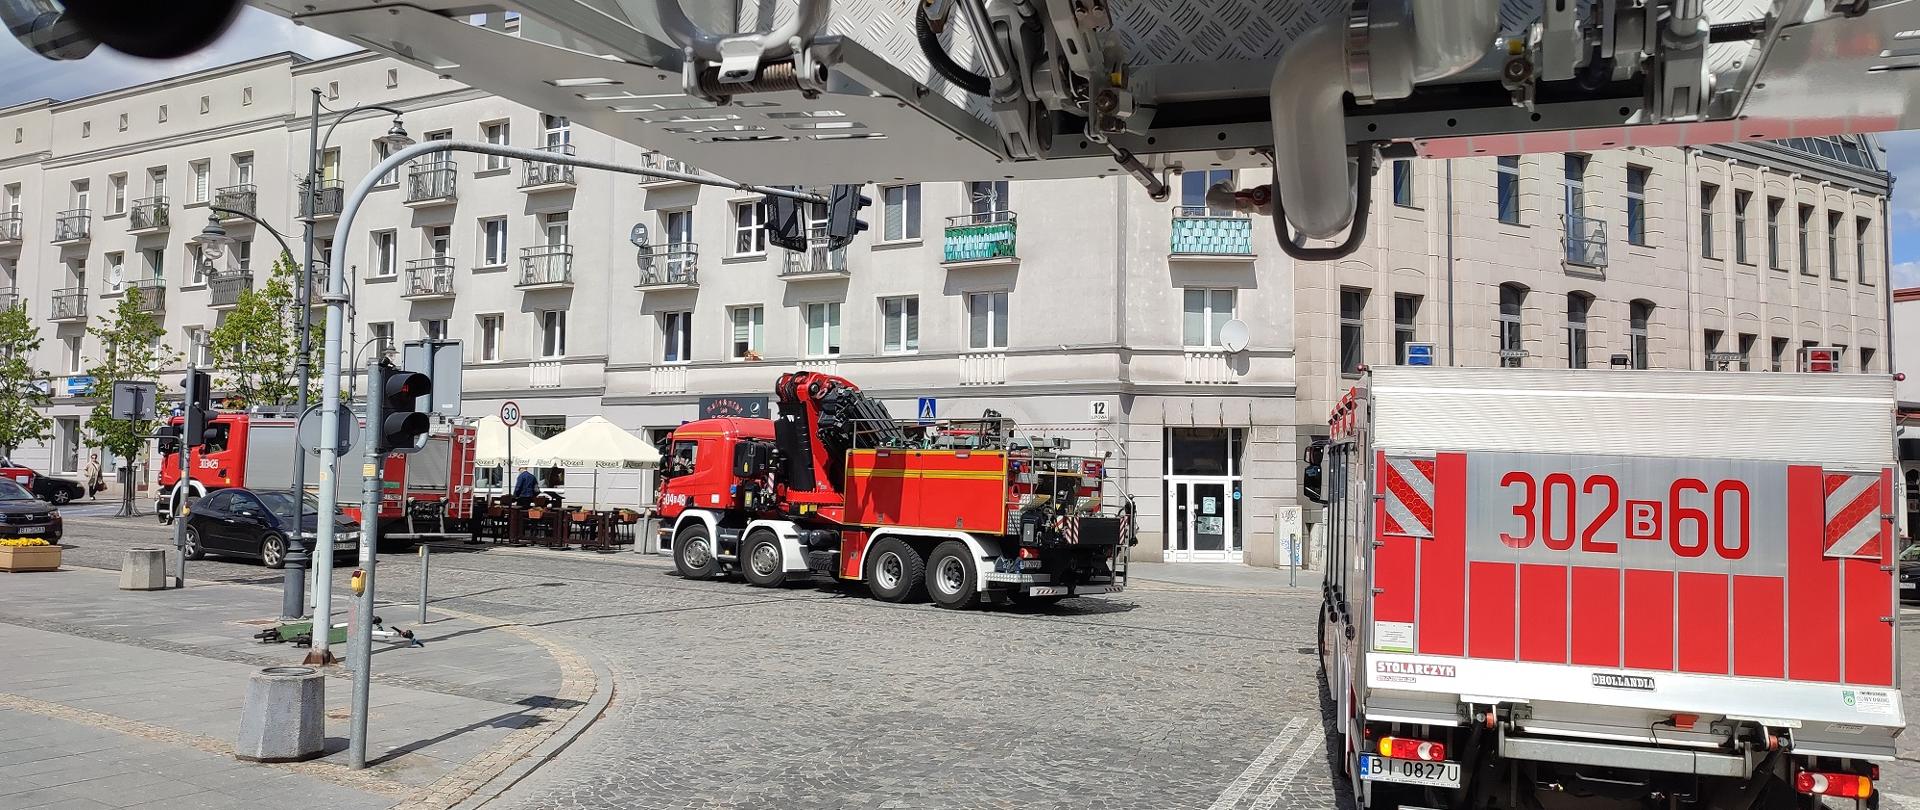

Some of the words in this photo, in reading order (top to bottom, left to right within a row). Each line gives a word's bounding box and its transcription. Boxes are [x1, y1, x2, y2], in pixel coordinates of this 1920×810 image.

[503, 407, 517, 420] 30
[1093, 402, 1105, 414] 12
[595, 460, 621, 469] Kozel
[1376, 661, 1456, 677] STOLARCZYK
[1592, 674, 1655, 690] DHOLLANDIA
[1403, 761, 1458, 782] 0827U
